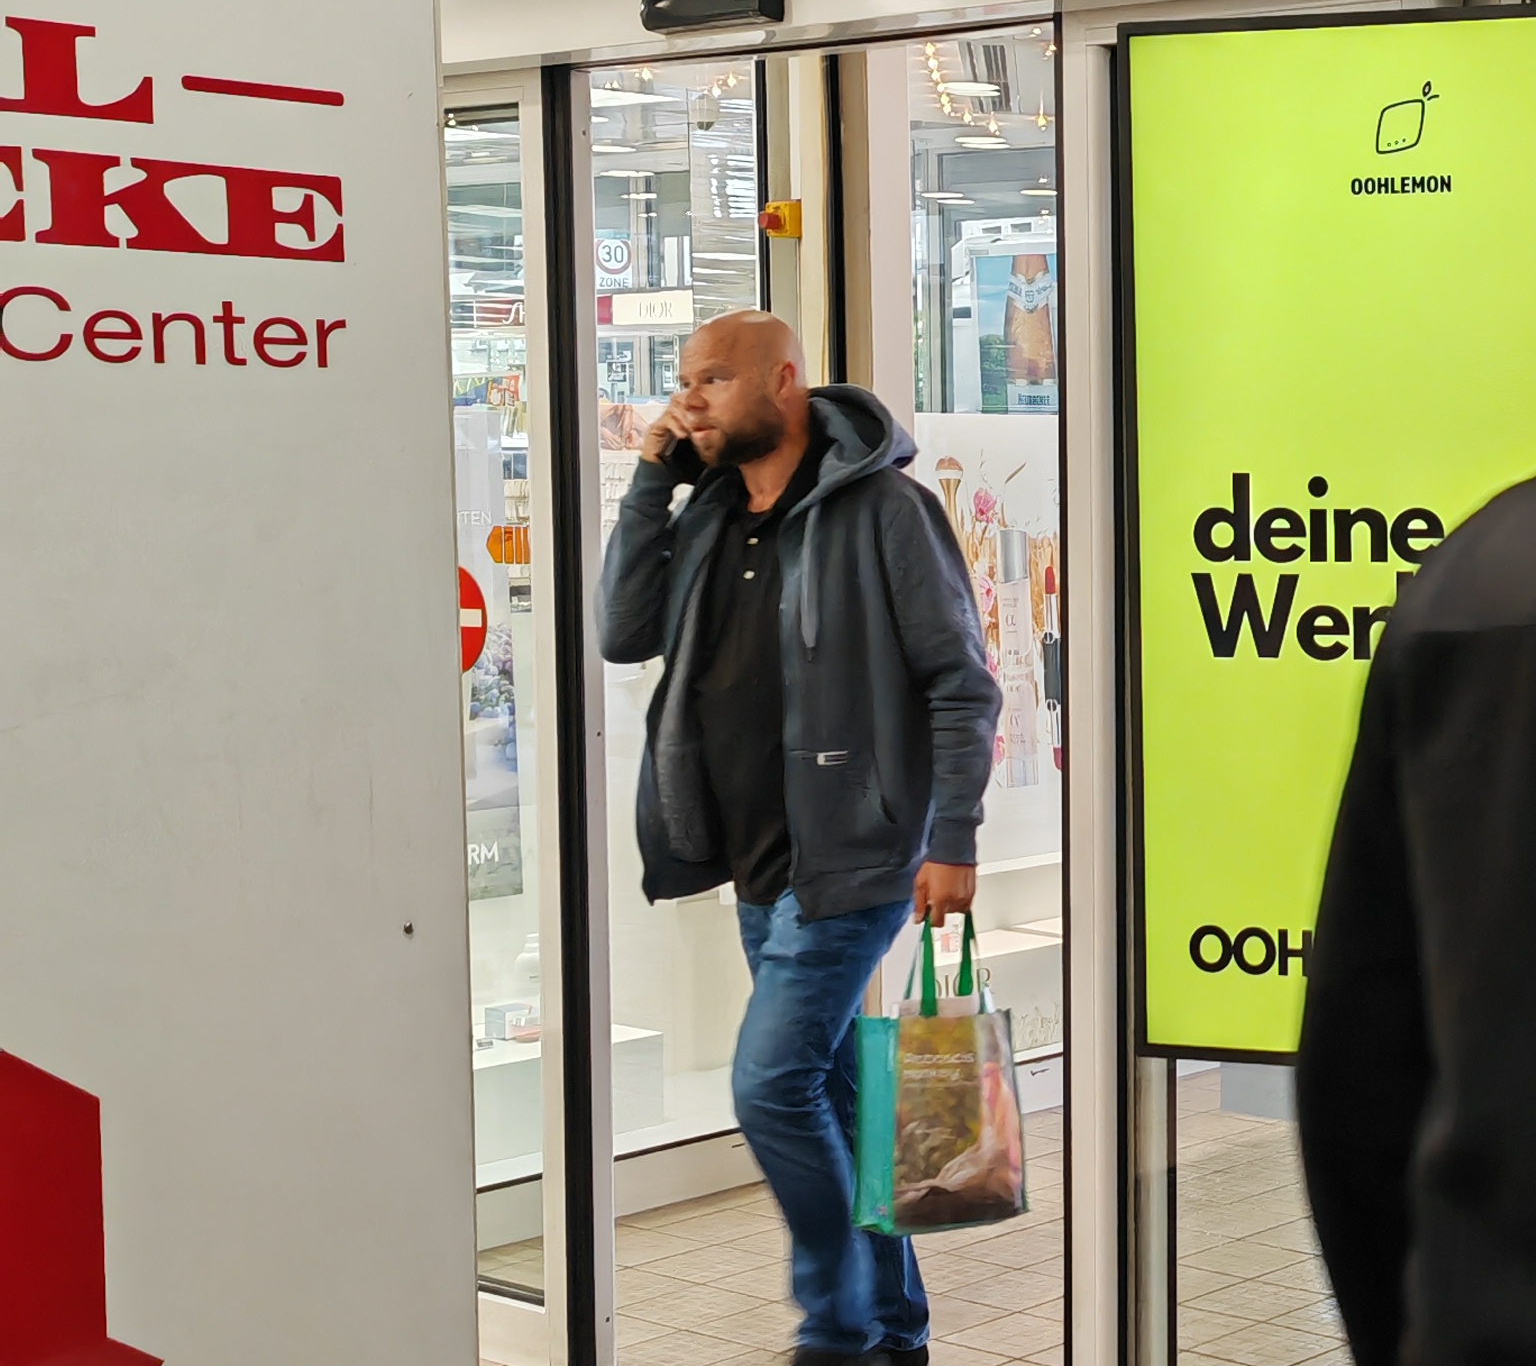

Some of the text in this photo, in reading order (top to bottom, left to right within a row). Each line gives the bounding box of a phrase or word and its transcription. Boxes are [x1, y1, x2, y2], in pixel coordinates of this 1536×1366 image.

[0, 16, 154, 125] L
[0, 145, 346, 263] KE
[1350, 174, 1452, 196] OOHLEMON
[598, 276, 630, 289] ZONE
[600, 244, 624, 264] 30
[0, 285, 347, 369] Center
[457, 509, 492, 525] TEN
[1193, 472, 1445, 563] deine
[1190, 571, 1416, 661] Wer
